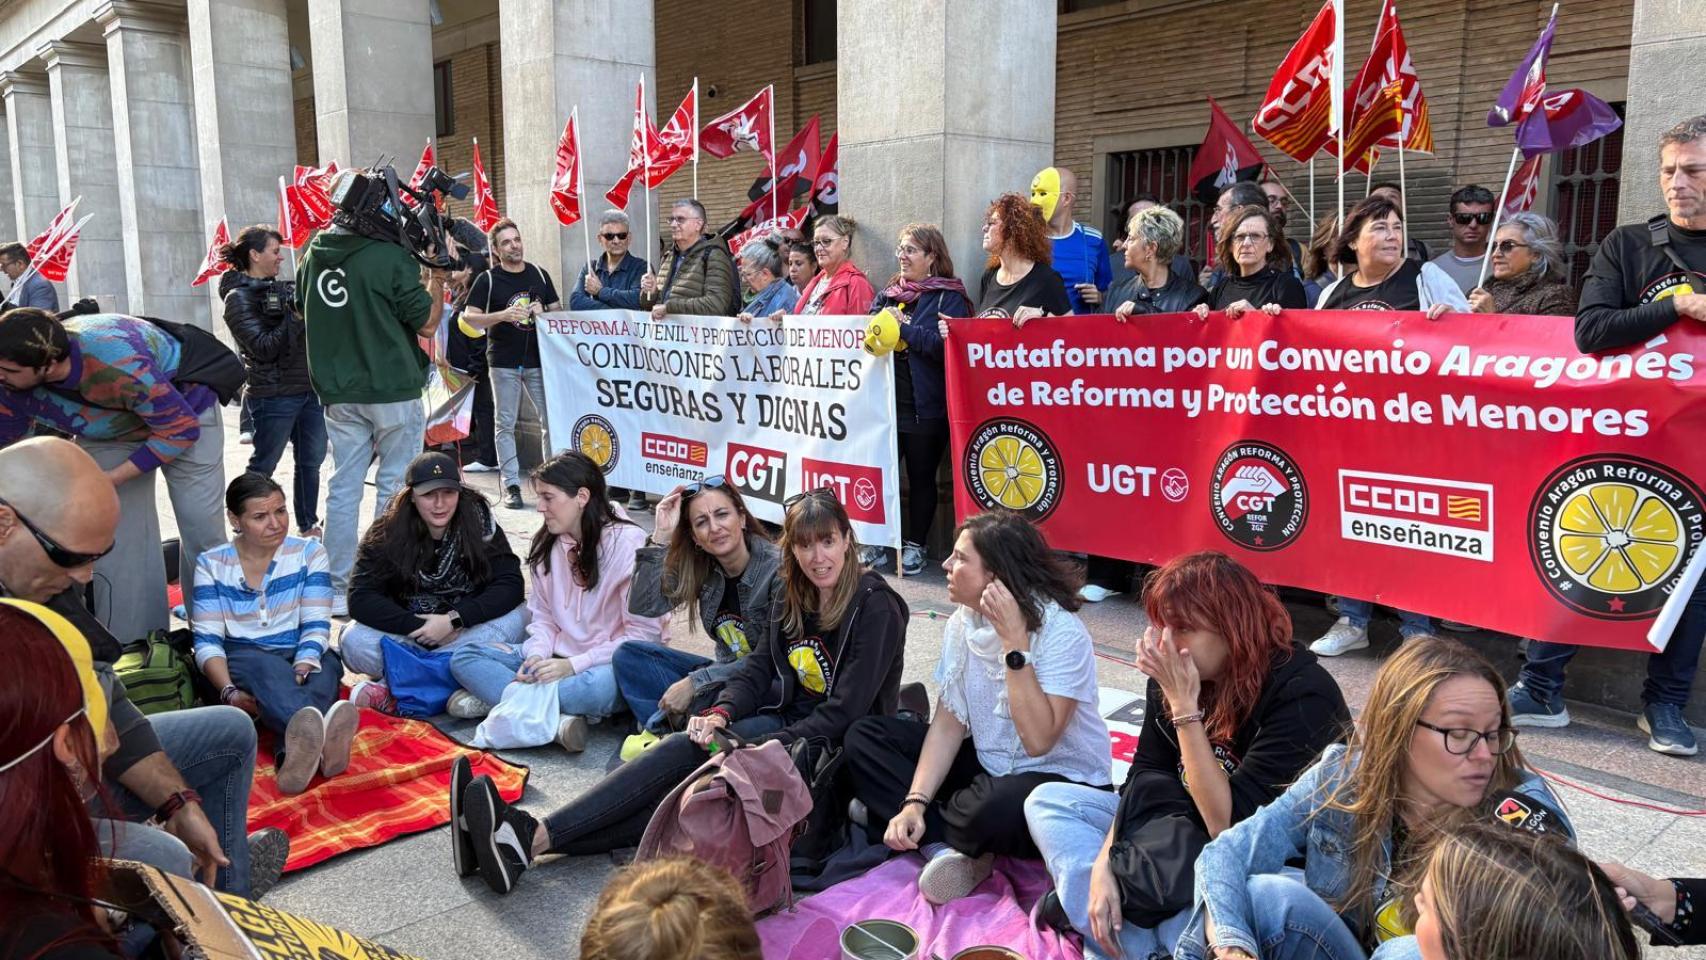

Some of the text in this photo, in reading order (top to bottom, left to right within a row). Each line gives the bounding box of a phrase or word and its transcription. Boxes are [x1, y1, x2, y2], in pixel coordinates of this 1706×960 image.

[547, 319, 630, 336] REFORMA
[633, 321, 689, 342] JUVENIL
[690, 325, 699, 343] Y
[790, 328, 805, 347] DE
[808, 329, 866, 349] MENOR
[576, 342, 862, 391] CONDICIONES LABORALES
[967, 334, 1694, 388] Plataforma por un Convenio Aragonés
[596, 378, 847, 441] SEGURAS Y DIGNAS
[987, 378, 1650, 437] de Reforma y Protección de Menores
[645, 438, 688, 459] CCOO
[973, 426, 999, 451] Aragón
[1000, 424, 1044, 448] Reforma
[645, 462, 704, 481] enseñanza
[730, 451, 784, 496] CGT
[969, 452, 987, 500] Convenio
[1037, 459, 1058, 512] Protección
[1087, 462, 1156, 497] UGT
[1548, 467, 1597, 504] Aragón
[1603, 464, 1682, 501] Reforma
[1213, 447, 1303, 537] CONVENIO ARAGÓN REFORMA Y PROTECCIÓN
[1236, 495, 1276, 512] CGT
[1349, 483, 1440, 516] CCOO
[1678, 500, 1695, 513] y
[1351, 517, 1483, 555] enseñanza
[1539, 505, 1561, 579] Convenio
